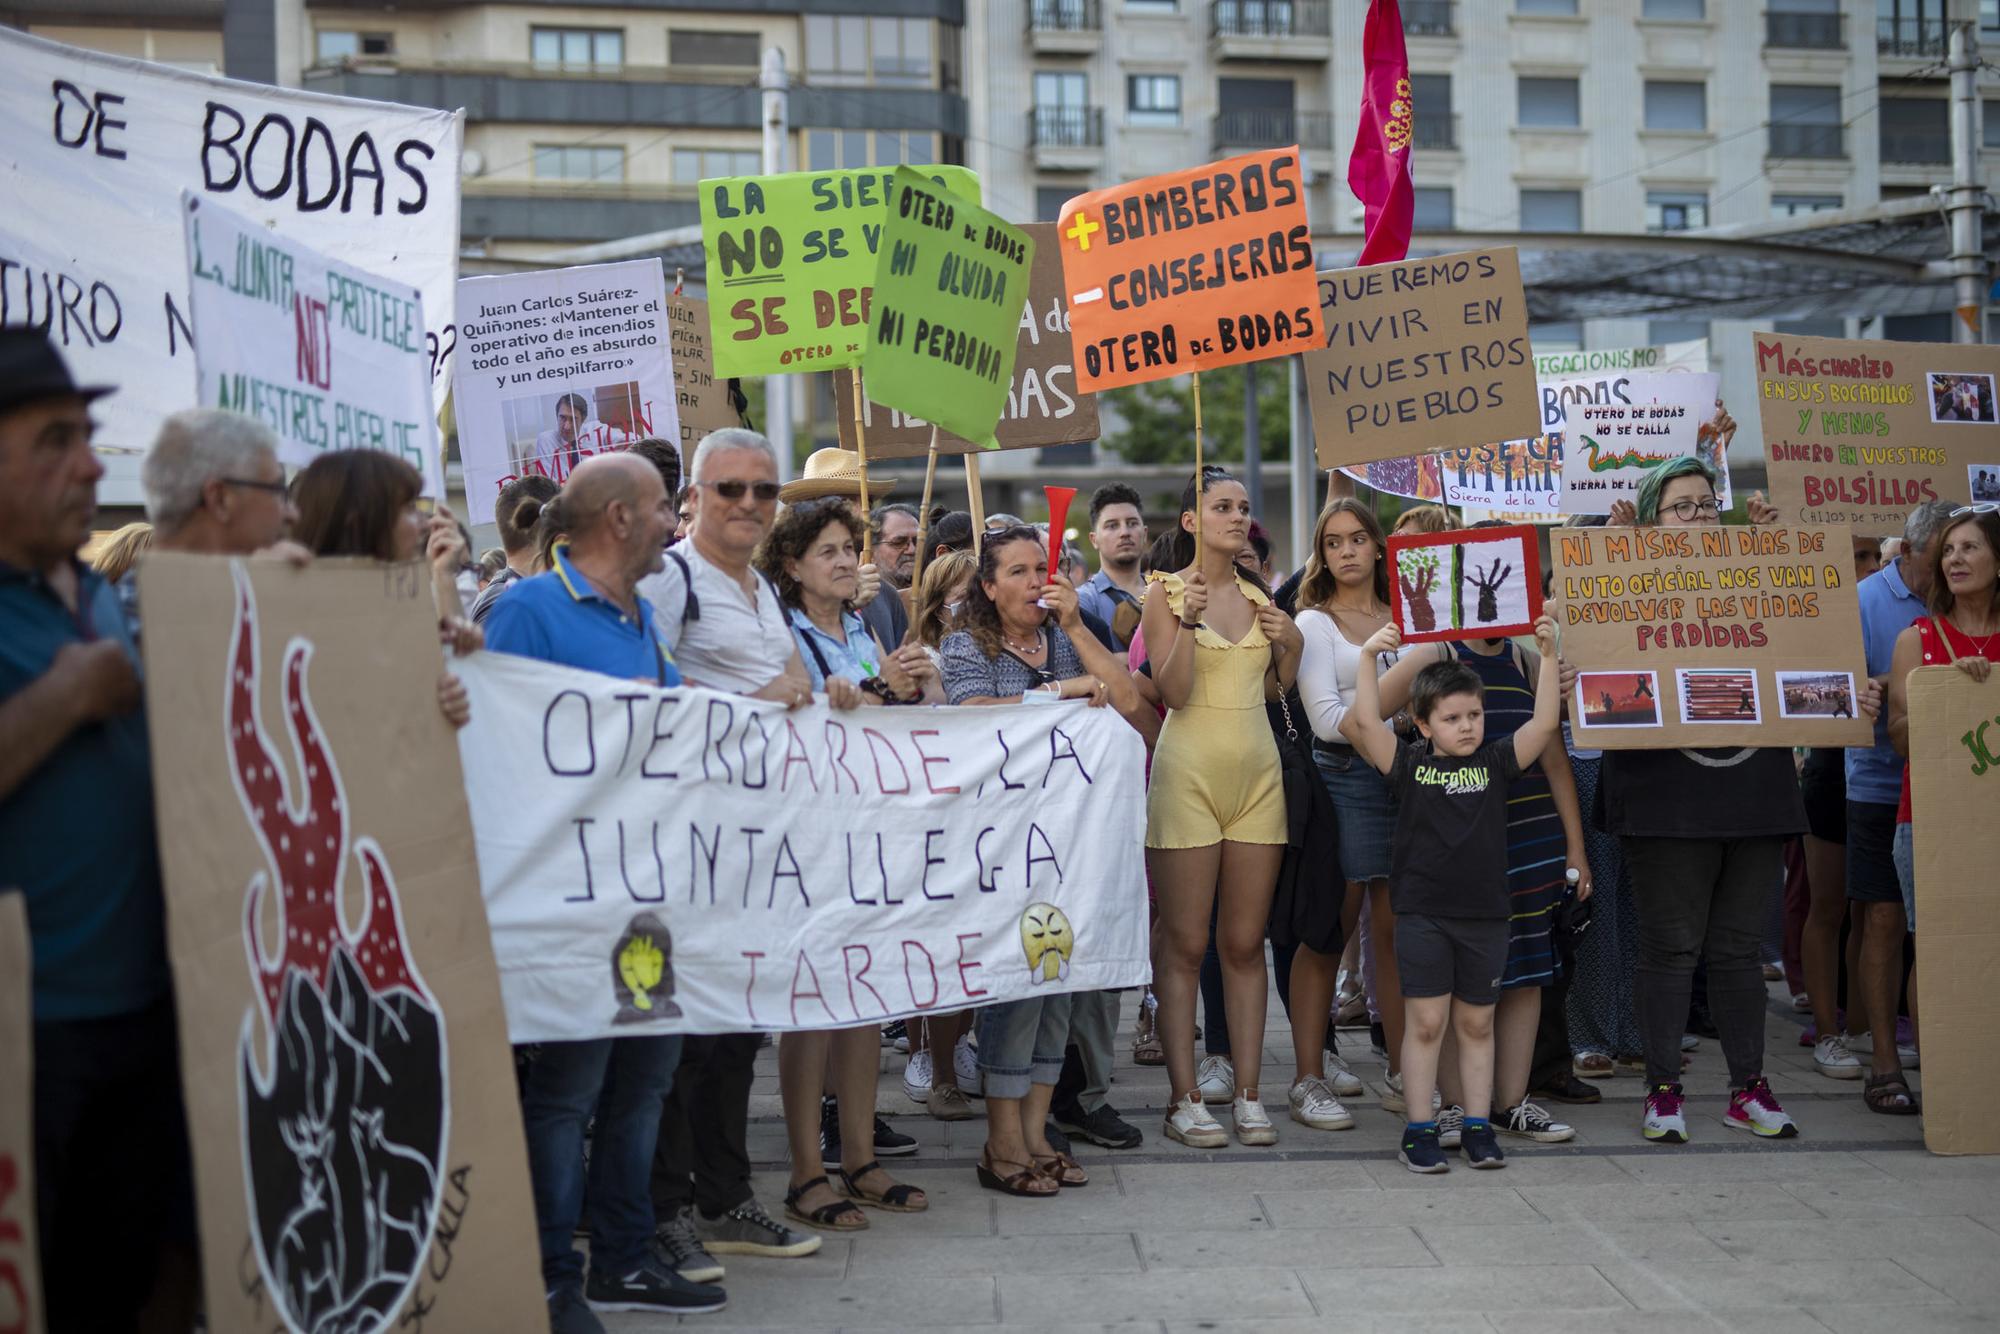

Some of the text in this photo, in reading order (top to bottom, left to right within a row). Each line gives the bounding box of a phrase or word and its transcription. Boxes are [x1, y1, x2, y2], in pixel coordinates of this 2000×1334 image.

[52, 79, 436, 215] DE BODAS
[714, 181, 765, 218] LA
[1103, 156, 1297, 245] BOMBEROS
[900, 186, 954, 231] OTERO
[985, 225, 1025, 265] BODAS
[718, 226, 783, 277] NO
[802, 228, 849, 263] SE
[1108, 225, 1313, 310] CONSEJEROS
[227, 231, 296, 315] JUNTA
[326, 271, 419, 353] PROTEGE
[891, 239, 1006, 307] NI OLVIDA
[1317, 255, 1496, 308] QUEREMOS
[463, 300, 659, 339] Quiñones: «Mantener el
[479, 288, 639, 318] Juan Carlos Suárez-
[731, 296, 789, 341] SE
[1464, 297, 1502, 325] EN
[295, 291, 331, 391] NO
[470, 318, 655, 355] operativo de incendios
[472, 354, 509, 370] todo
[515, 350, 531, 363] el
[535, 346, 565, 361] año
[570, 344, 588, 356] es
[593, 334, 657, 352] absurdo
[780, 343, 859, 365] OTERO DE
[878, 306, 1001, 384] NI PERDONA
[1085, 307, 1314, 377] OTERO DE BODAS
[496, 358, 634, 389] y un despilfarro»
[1328, 338, 1525, 395] NUESTROS
[1534, 347, 1657, 374] EGACIONISMO
[219, 373, 328, 449] NUESTROS
[1347, 382, 1503, 434] PUEBLOS
[1764, 381, 1916, 405] EN SUS BOCADILLOS
[1584, 407, 1685, 420] OTERO DE BODAS
[1596, 424, 1670, 435] NO SE CALLA
[1797, 409, 1890, 436] Y MENOS
[1771, 440, 1947, 465] DINERO EN VUESTROS
[1449, 486, 1560, 507] Sierra de la C
[1571, 480, 1606, 490] SIERRA
[1612, 480, 1624, 489] DE
[1803, 470, 1938, 507] BOLSILLOS
[1561, 531, 1594, 567] NI
[1702, 528, 1732, 558] NI
[1737, 527, 1790, 556] DIAS
[1798, 531, 1825, 555] DE
[1565, 564, 1841, 600] LUTO OFICIAL NOS VAN A
[1566, 591, 1820, 625] DEVOLVER LAS VIDAS
[1636, 618, 1768, 650] PERDIDAS
[542, 689, 770, 790] OTERO
[998, 725, 1093, 791] LA
[1445, 782, 1486, 795] Beach
[563, 817, 1063, 909] JUNTA LLEGA
[741, 932, 988, 1027] TARDE
